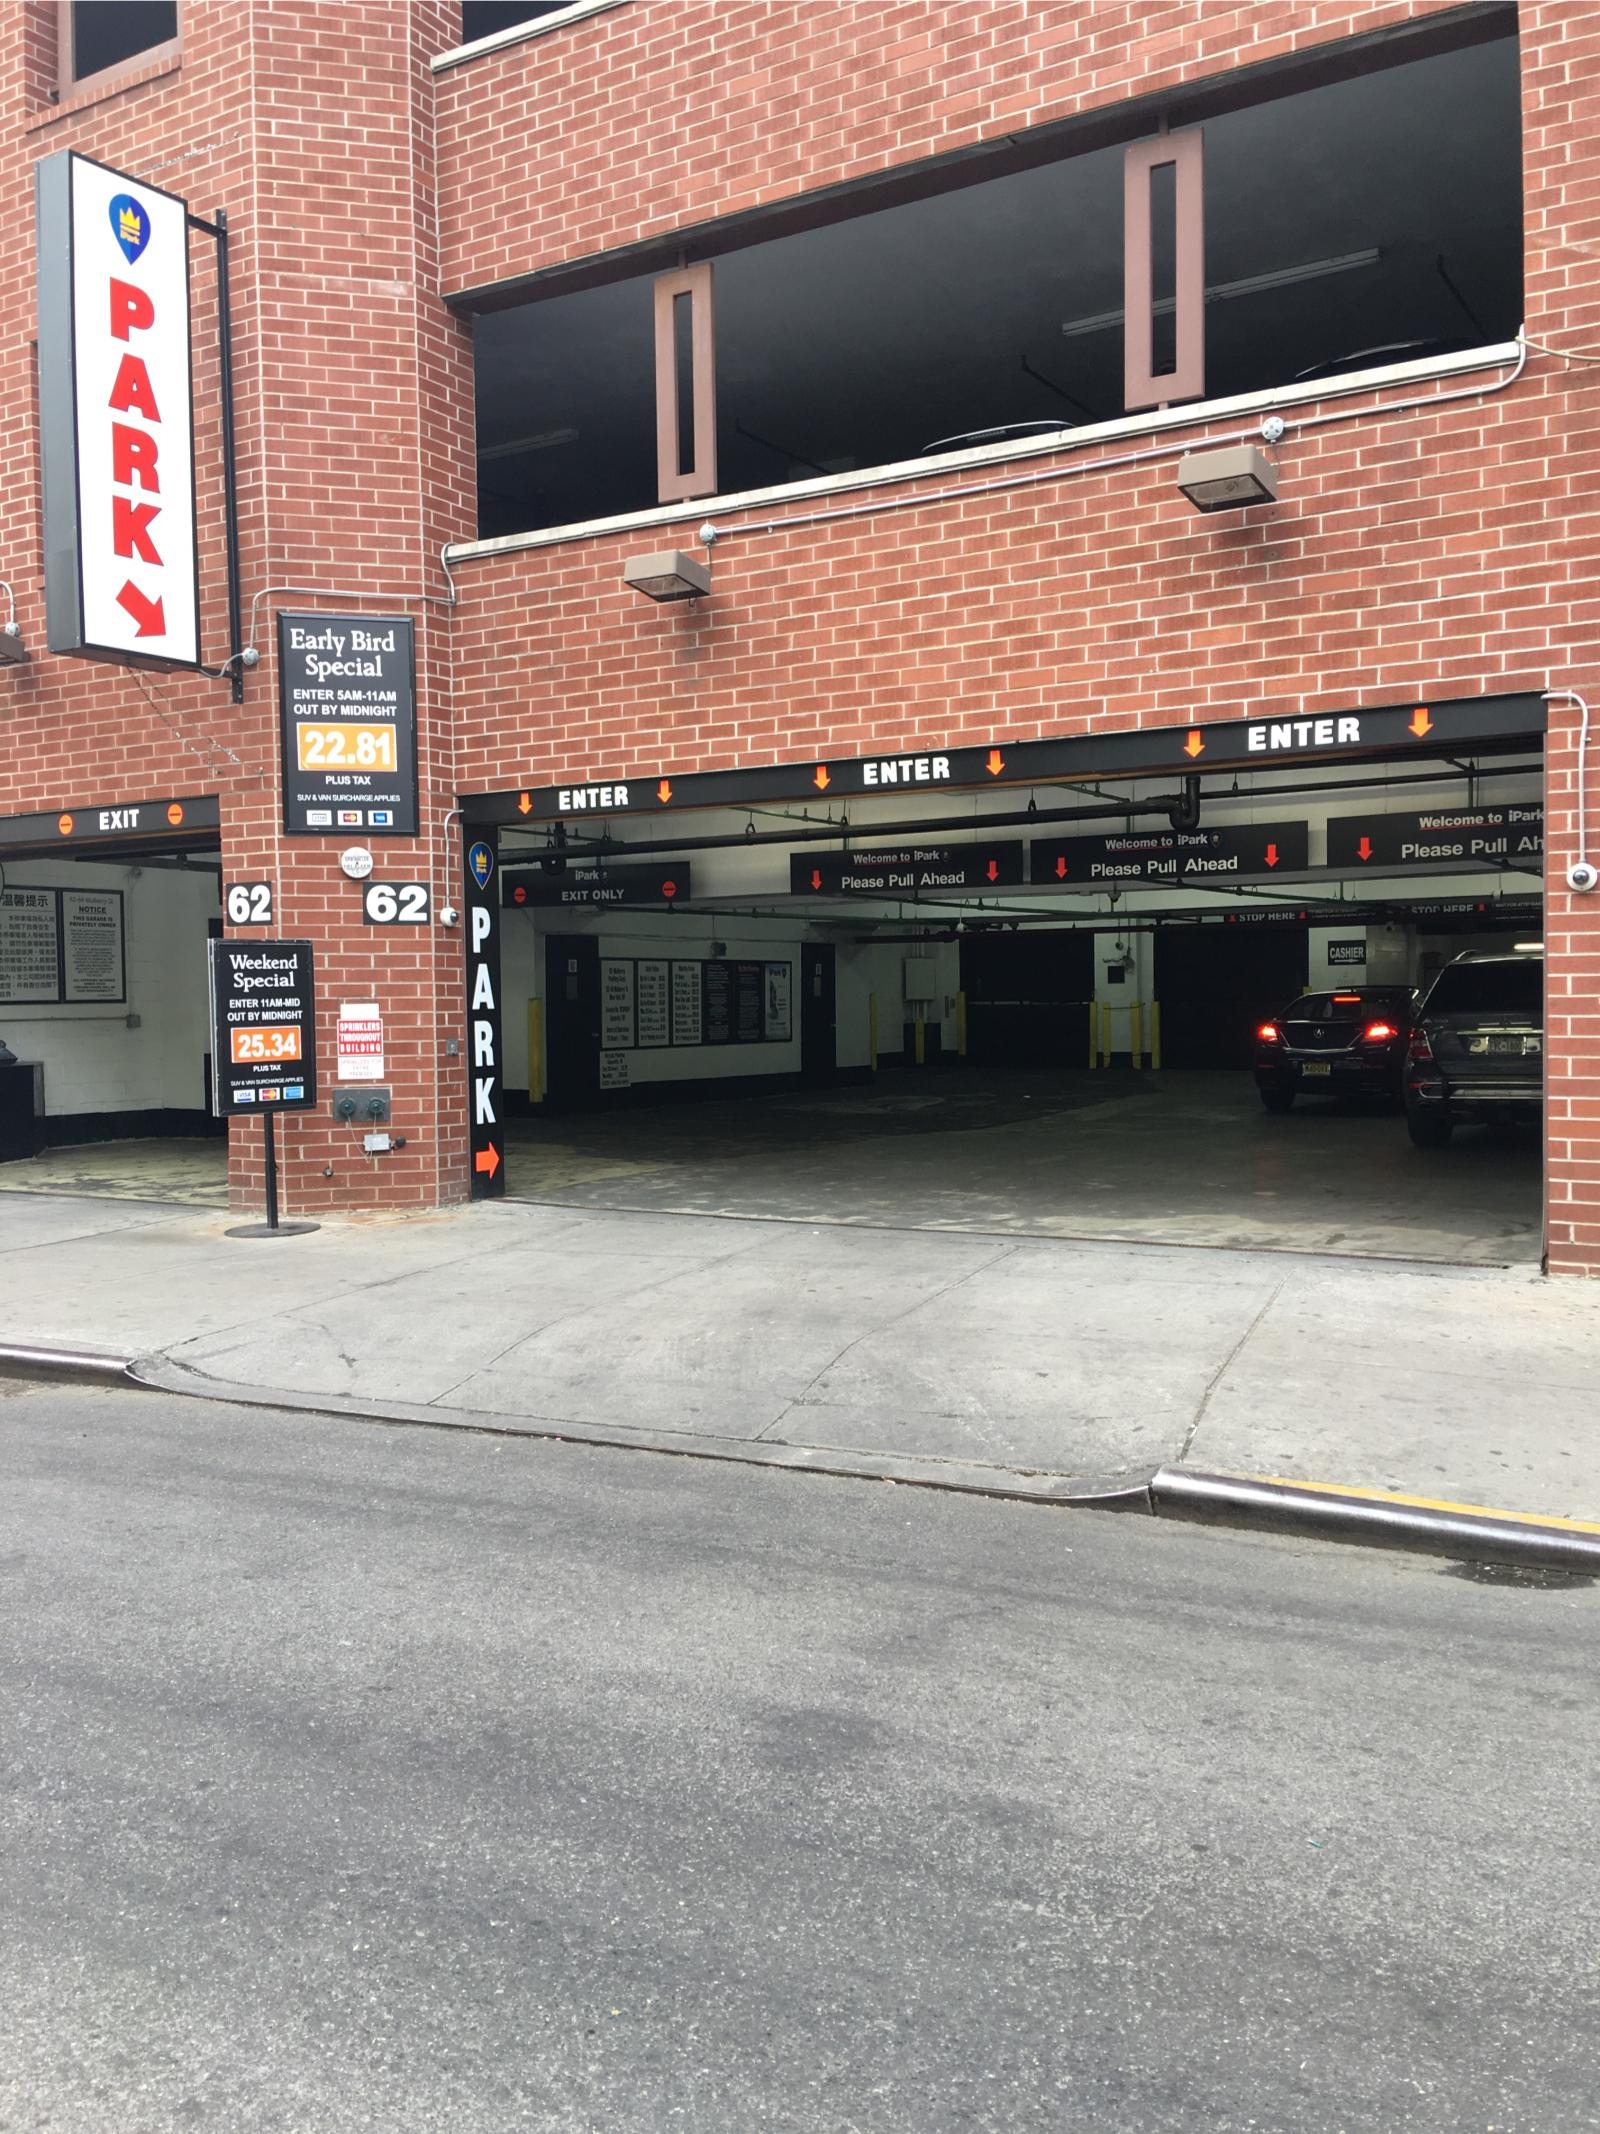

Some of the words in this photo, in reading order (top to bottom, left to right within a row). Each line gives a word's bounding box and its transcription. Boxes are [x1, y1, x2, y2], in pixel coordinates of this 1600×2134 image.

[108, 276, 165, 567] PARK
[290, 628, 346, 657] Early
[351, 630, 396, 652] Bird
[305, 654, 383, 682] Special
[293, 689, 334, 701] ENTER
[337, 690, 397, 702] 5AM-11AM
[293, 704, 318, 715] OUT
[322, 705, 338, 716] BY
[340, 705, 397, 717] MIDNIGHT
[1248, 717, 1360, 752] ENTER
[304, 730, 392, 766] 22.81
[863, 757, 950, 785] ENTER
[325, 776, 350, 786] PLUS
[352, 776, 371, 786] TAX
[297, 794, 311, 802] SUV
[318, 794, 331, 802] VAN
[332, 794, 373, 802] SURCHARGE
[559, 785, 629, 811] ENTER
[99, 809, 140, 830] EXIT
[1419, 815, 1484, 829] Welcome
[1487, 812, 1503, 824] to
[1105, 838, 1158, 850] Welcome
[1161, 836, 1174, 847] to
[1177, 833, 1208, 846] iPark
[1401, 843, 1464, 859] Please
[1471, 837, 1508, 854] Pull
[853, 854, 898, 864] Welcome
[900, 852, 911, 862] to
[914, 850, 940, 861] iPark
[575, 870, 599, 880] iPark
[1091, 863, 1142, 877] Please
[1147, 859, 1177, 874] Pull
[1184, 856, 1238, 872] Ahead
[841, 876, 884, 889] Please
[889, 873, 914, 887] Pull
[920, 871, 965, 886] Ahead
[228, 884, 271, 923] 62
[366, 884, 428, 922] 62
[562, 890, 589, 901] EXIT
[592, 889, 625, 900] ONLY
[79, 906, 107, 914] NOTICE
[1239, 913, 1265, 922] STOP
[1268, 912, 1296, 921] HERE
[1330, 946, 1364, 959] CASHIER
[229, 953, 299, 970] Weekend
[233, 971, 295, 992] Special
[229, 999, 259, 1008] ENTER
[260, 998, 301, 1008] 11AM-MID
[227, 1012, 246, 1021] OUT
[248, 1012, 260, 1021] BY
[261, 1010, 303, 1020] MIDNIGHT
[472, 906, 497, 1126] PARK
[339, 1022, 380, 1031] SPRINKLERS
[237, 1032, 297, 1058] 25.34
[340, 1033, 381, 1042] THROUGHOUT
[340, 1043, 381, 1053] BUILDING
